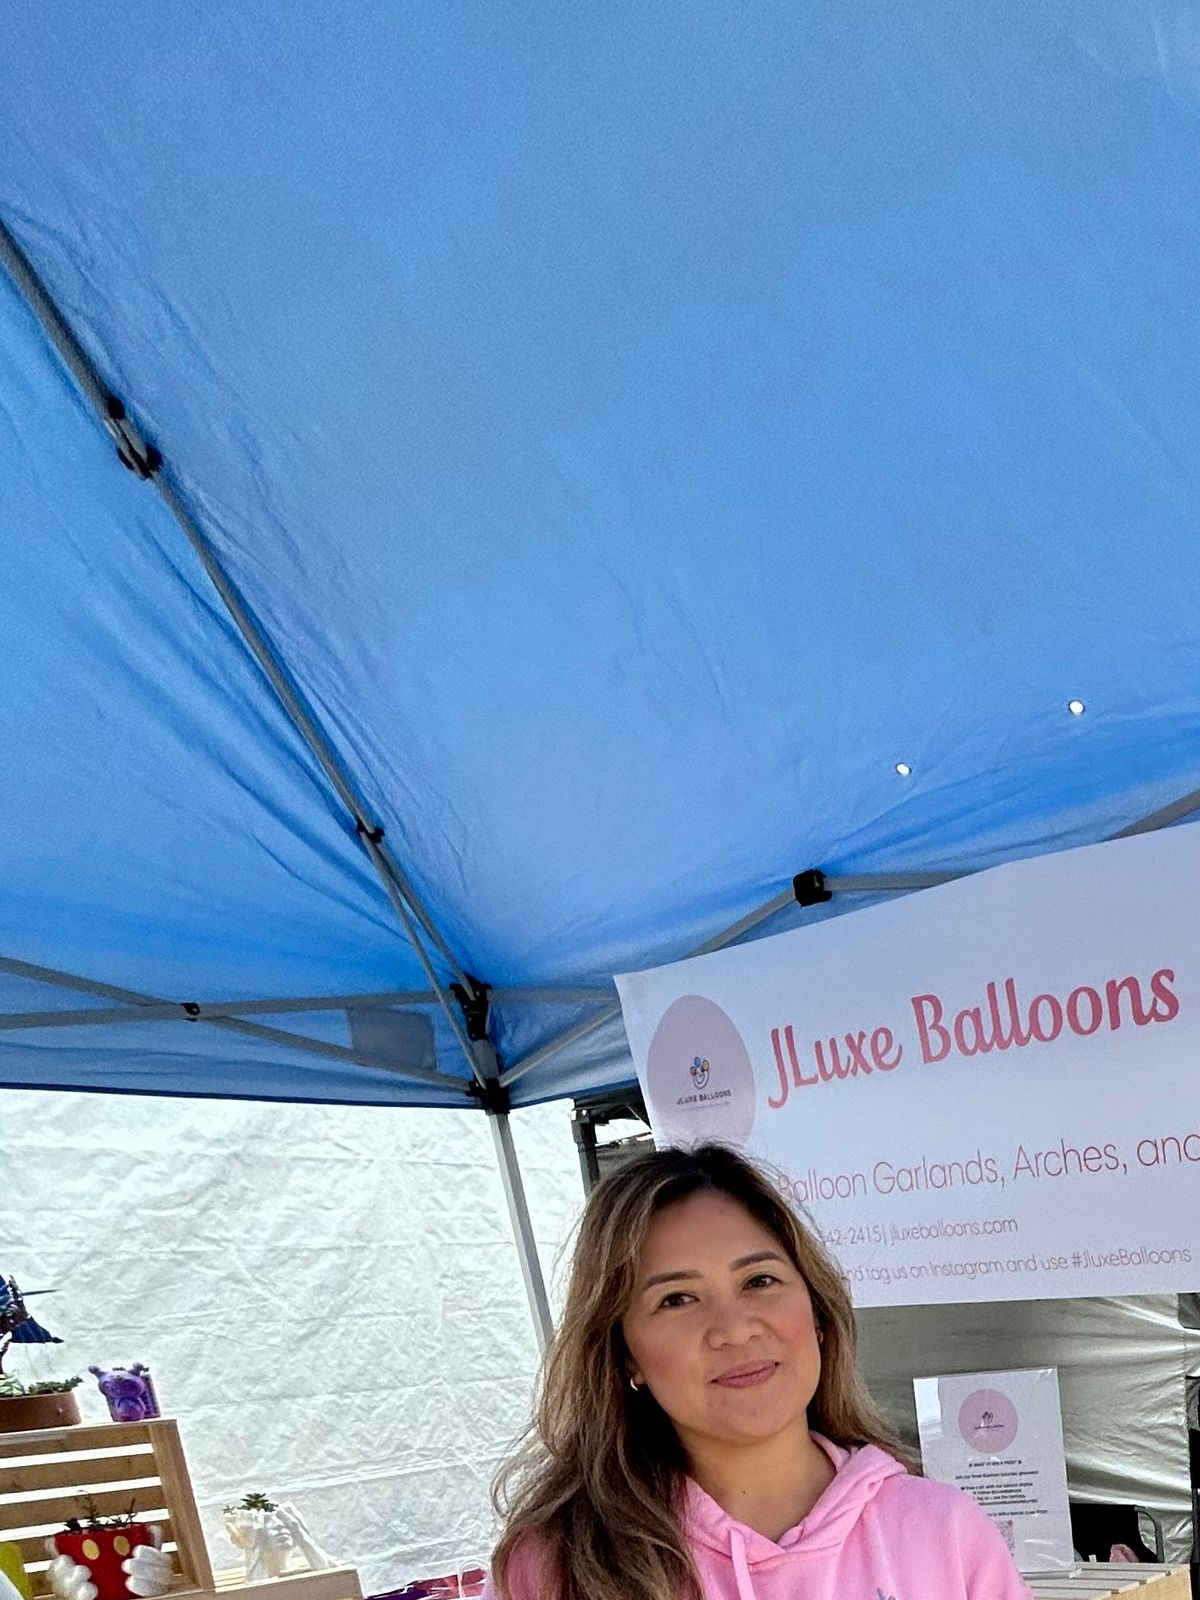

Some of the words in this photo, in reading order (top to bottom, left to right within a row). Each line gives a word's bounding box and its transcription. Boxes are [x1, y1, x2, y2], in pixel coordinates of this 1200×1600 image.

[767, 1024, 903, 1110] JLuxe
[910, 968, 1180, 1064] Balloons
[872, 1148, 1005, 1195] Garlands,
[1013, 1138, 1129, 1180] Arches,
[865, 1263, 892, 1285] tag
[892, 1266, 908, 1280] us
[909, 1264, 929, 1279] on
[929, 1260, 1006, 1280] Instagram
[1007, 1254, 1038, 1273] and
[1041, 1254, 1069, 1271] use
